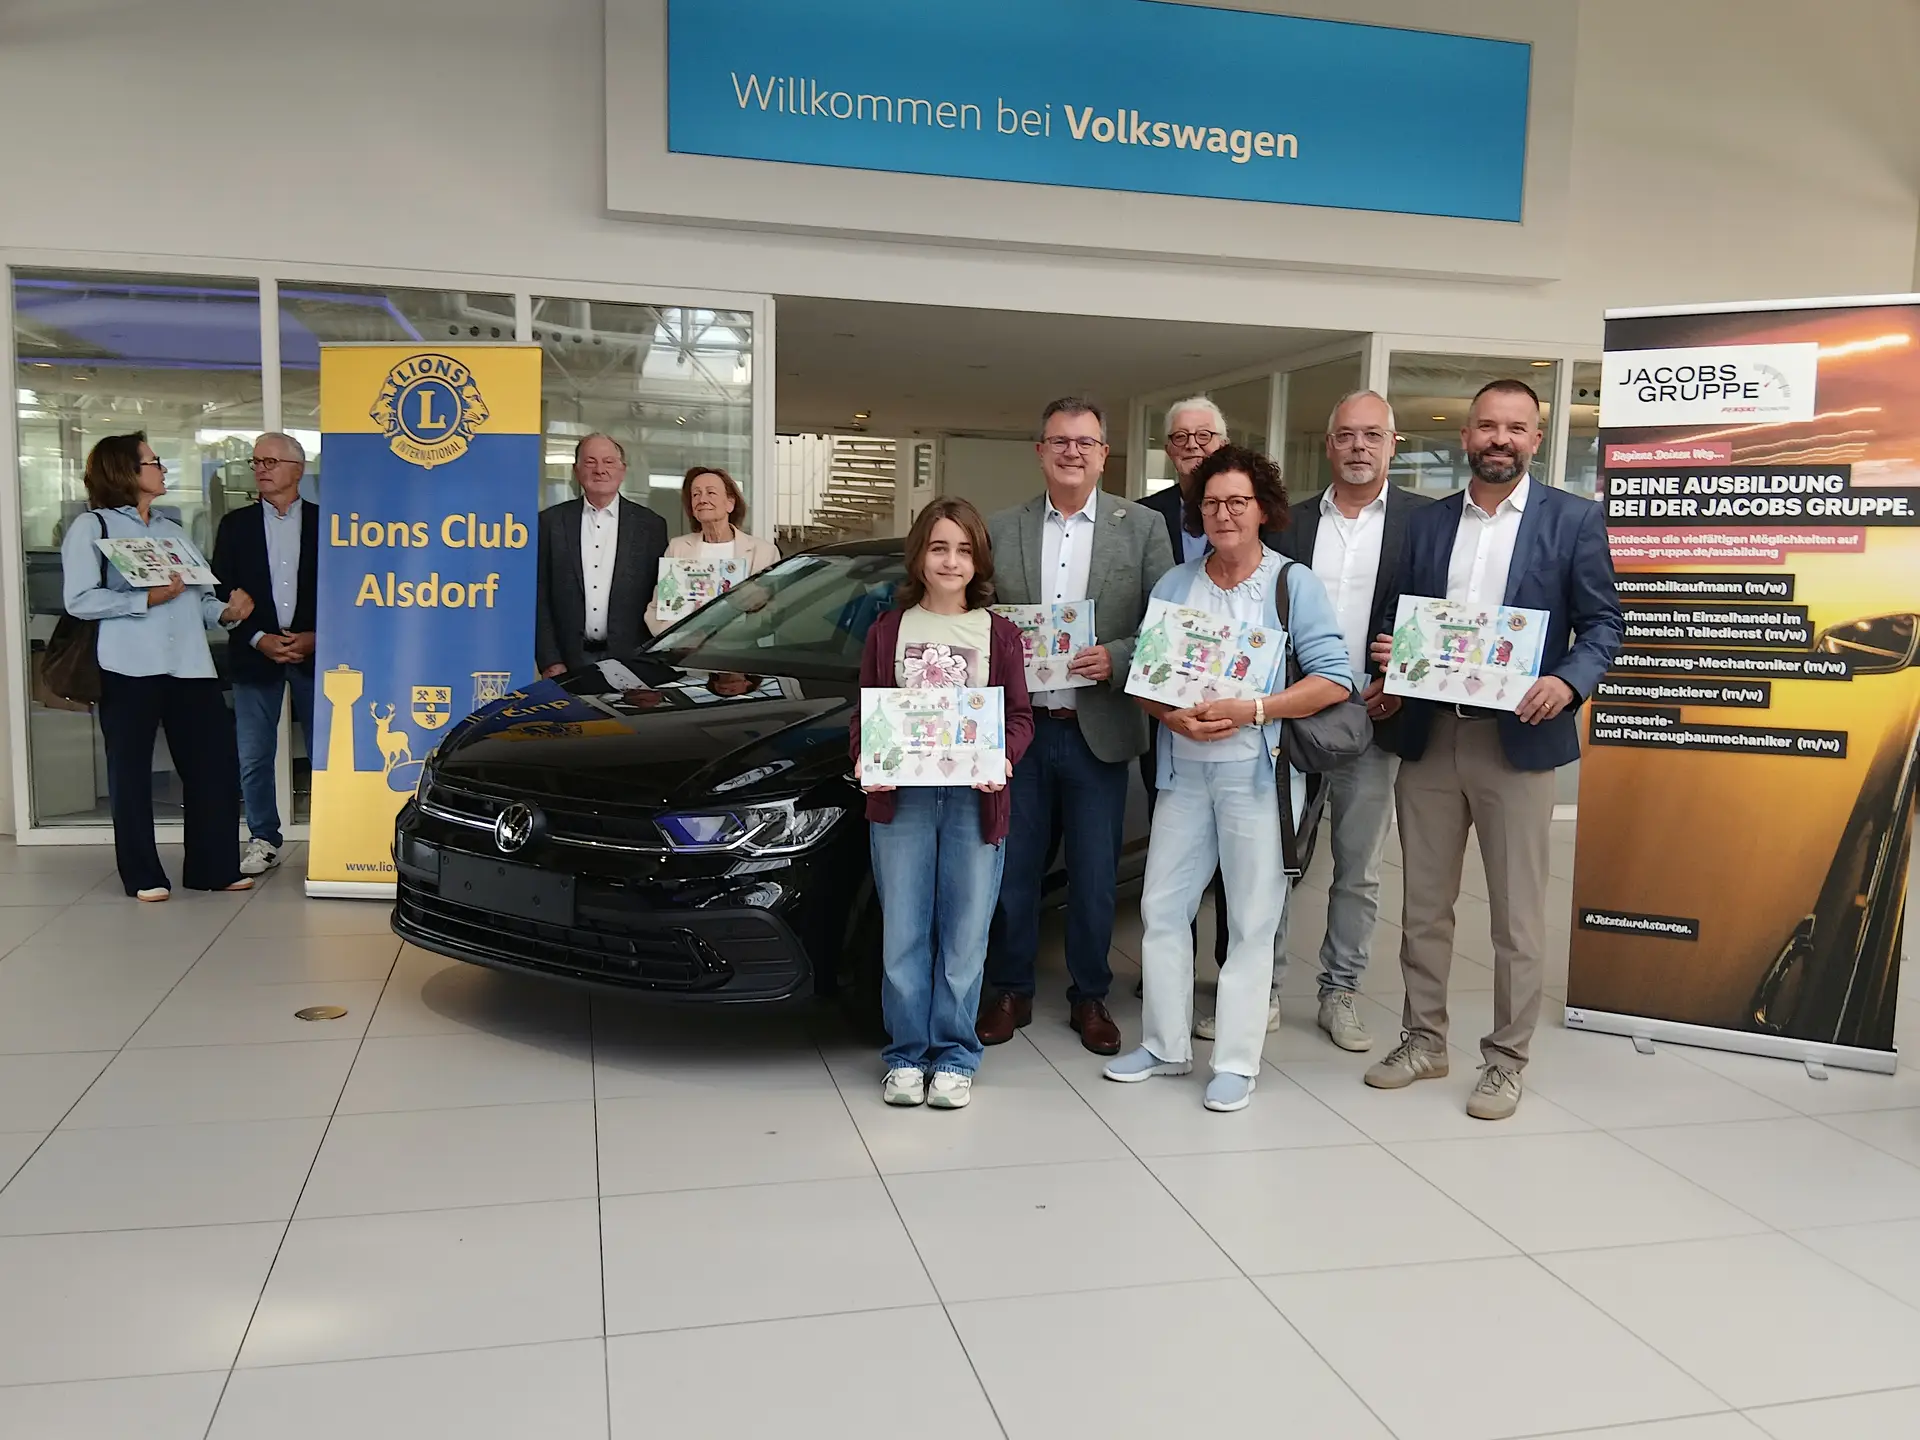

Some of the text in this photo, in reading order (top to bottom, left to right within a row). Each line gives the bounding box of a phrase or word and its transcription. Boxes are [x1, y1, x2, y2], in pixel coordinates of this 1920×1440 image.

[730, 71, 1299, 164] Willkommen bei Volkswagen
[396, 358, 464, 383] LIONS
[1619, 364, 1737, 385] JACOBS
[1638, 382, 1760, 403] GRUPPE
[416, 390, 447, 429] L
[395, 440, 463, 461] INTERNATIONAL
[1610, 474, 1844, 496] DEINE AUSBILDUNG
[1609, 497, 1915, 517] BEI DER JACOBS GRUPPE.
[330, 512, 529, 549] Lions Club
[1608, 533, 1859, 546] Entdecke die vielfältigen Möglichkeiten auf
[1609, 547, 1779, 559] acobs-gruppe.de/ausbildung
[355, 571, 500, 608] Alsdorf
[1613, 580, 1788, 595] utomobilkaufmann (m/w)
[1673, 611, 1691, 622] im
[1692, 611, 1782, 625] Einzelhandel
[1782, 613, 1801, 625] im
[1624, 625, 1807, 642] hbereich Teiledienst (m/w)
[1613, 654, 1847, 674] aftfahrzeug-Mechatroniker (m/w)
[1598, 683, 1764, 702] Fahrzeuglackierer (m/w)
[1596, 713, 1674, 727] Karosserie-
[1595, 728, 1840, 752] und Fahrzeugbaumechaniker (m/w)
